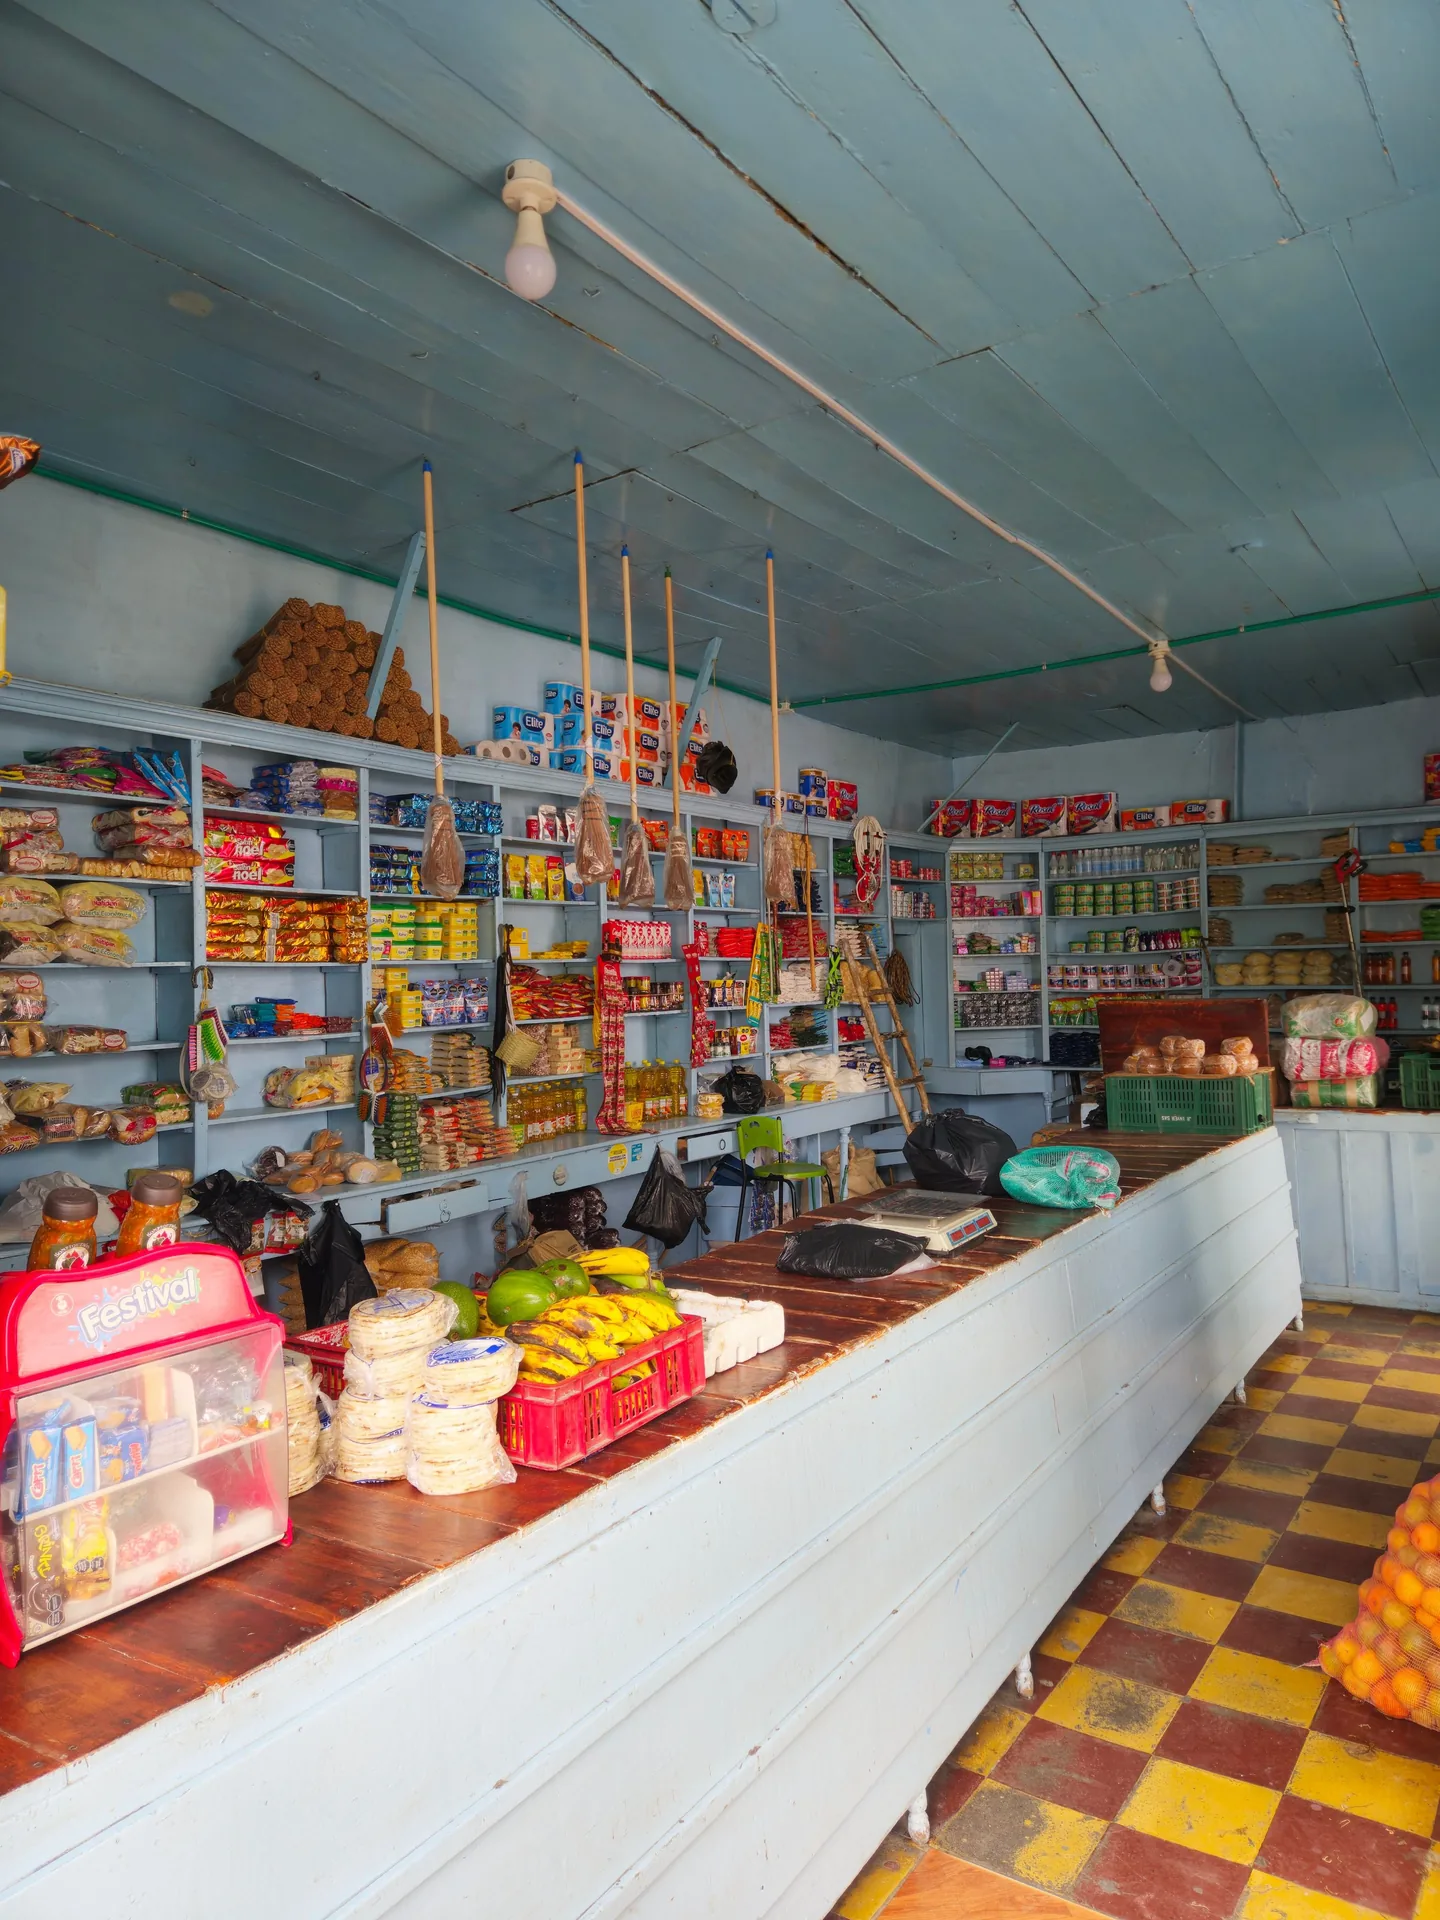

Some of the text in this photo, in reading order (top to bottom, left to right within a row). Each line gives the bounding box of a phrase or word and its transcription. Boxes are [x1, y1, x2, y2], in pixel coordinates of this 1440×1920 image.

[643, 703, 659, 716] Elite
[525, 715, 543, 729] Elite
[594, 725, 612, 738] Elite
[642, 736, 658, 748] Elite
[689, 742, 703, 754] Elite
[594, 760, 610, 772] Elite
[638, 770, 653, 781] Elite
[794, 802, 804, 811] Elite
[817, 806, 827, 814] Elite
[984, 806, 1009, 816] Rosal
[1029, 803, 1056, 815] Rosal
[1075, 800, 1102, 813] Rosal
[1186, 804, 1205, 813] Elite
[1135, 812, 1153, 821] Elite
[234, 840, 265, 856] noel
[232, 867, 263, 880] noel
[79, 1268, 196, 1343] Festival
